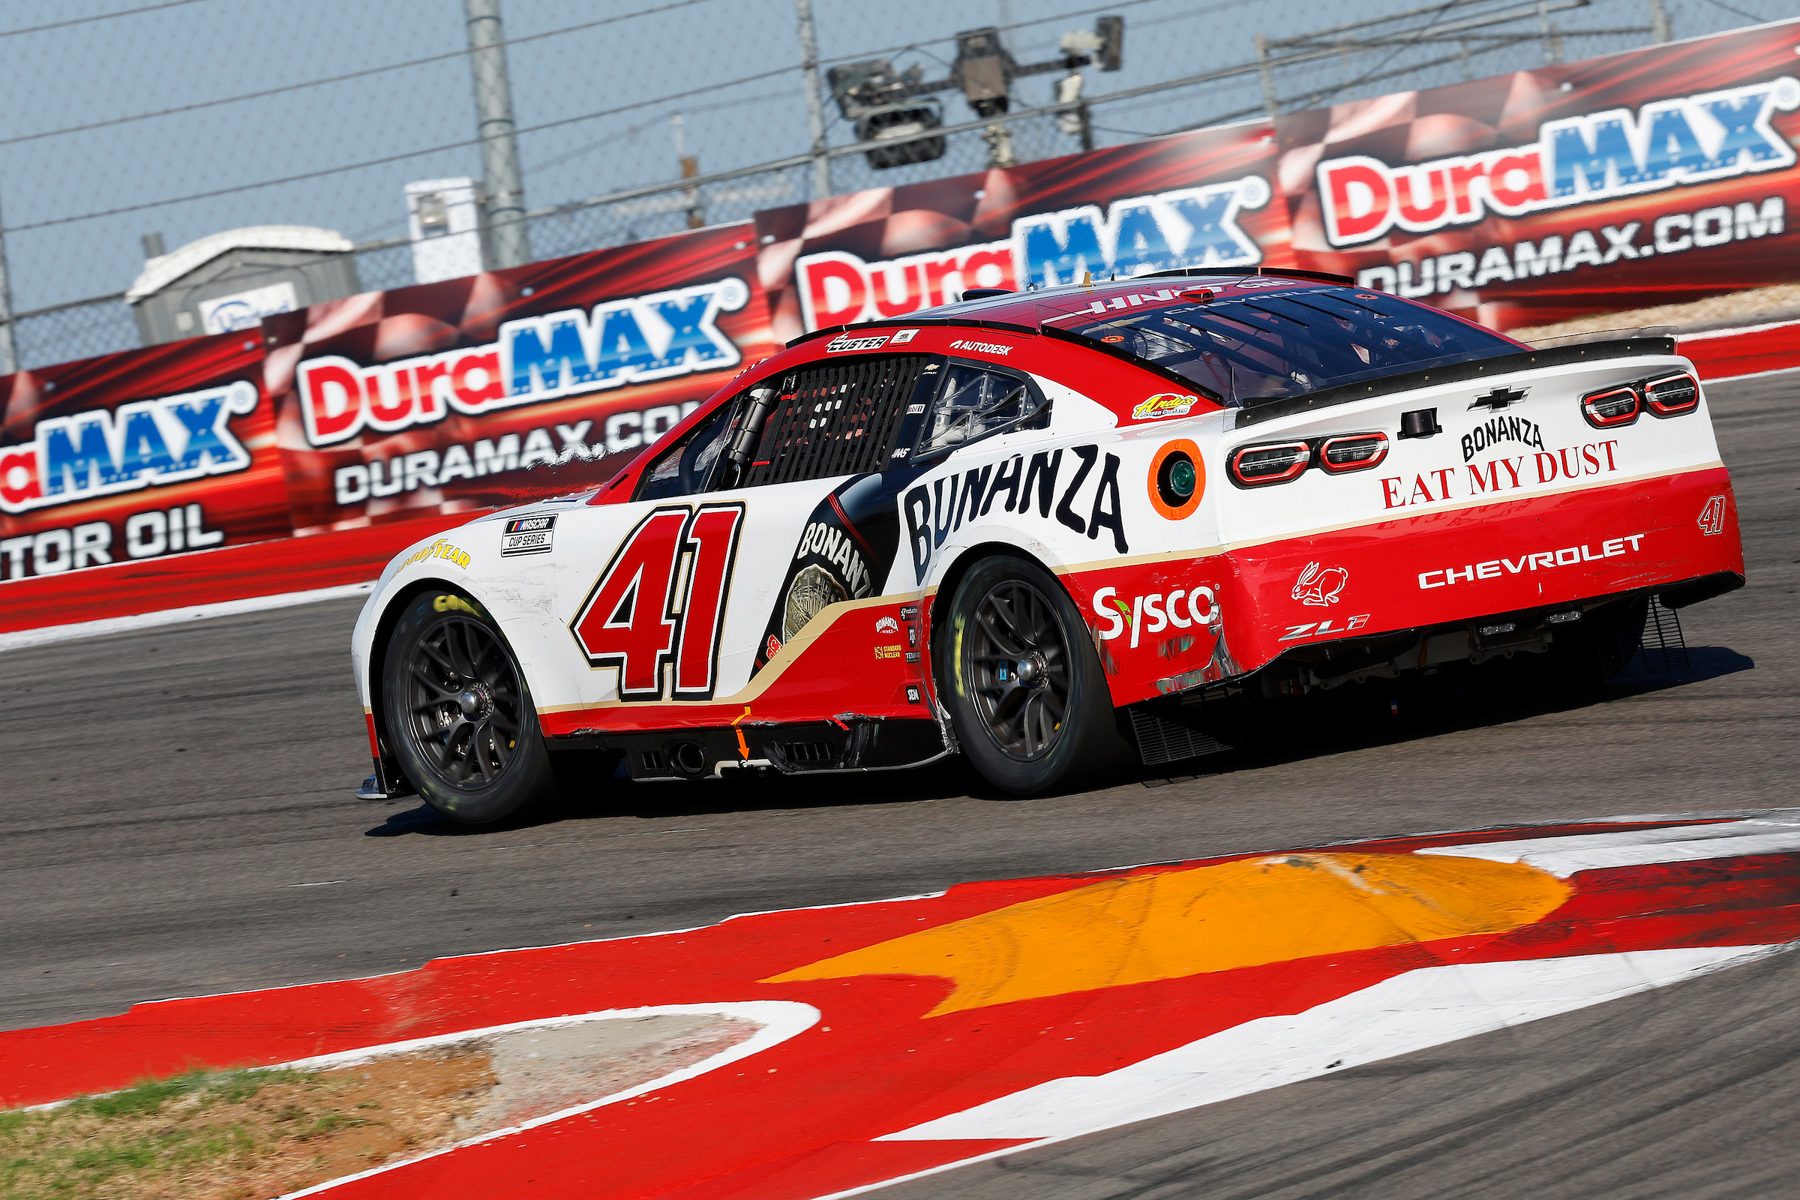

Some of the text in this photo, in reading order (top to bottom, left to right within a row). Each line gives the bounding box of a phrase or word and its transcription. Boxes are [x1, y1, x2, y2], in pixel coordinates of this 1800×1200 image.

[1322, 84, 1792, 243] DuraMAX
[800, 188, 1262, 328] DuraMAX
[1358, 195, 1785, 298] DURAMAX.COM
[303, 285, 738, 442] DuraMAX
[962, 340, 1013, 356] AUTODESK
[1134, 395, 1195, 417] Andy's
[1461, 416, 1545, 462] BONANZA
[1379, 440, 1619, 510] EAT MY DUST
[126, 503, 224, 558] OIL
[508, 533, 546, 547] CUP SERIES
[520, 518, 549, 531] NASCAR
[903, 444, 1129, 586] BONANZA
[1698, 495, 1726, 536] 41
[798, 522, 874, 600] BONANZ
[1418, 533, 1645, 590] CHEVROLET
[572, 501, 745, 701] 41
[876, 616, 899, 632] BONANZA
[1278, 614, 1371, 641] ZL1
